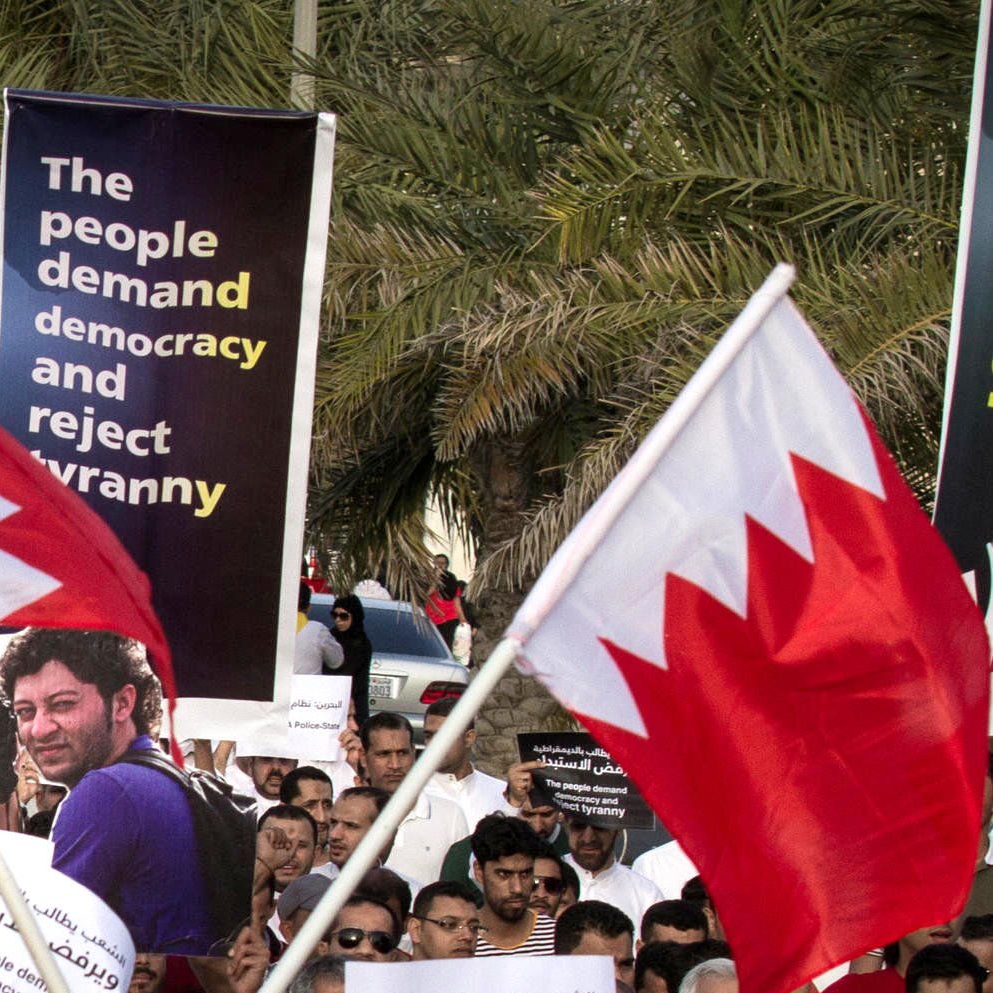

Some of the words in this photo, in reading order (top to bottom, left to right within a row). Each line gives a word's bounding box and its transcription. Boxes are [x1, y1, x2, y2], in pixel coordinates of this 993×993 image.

[41, 156, 133, 202] The
[40, 210, 218, 266] people
[37, 252, 250, 310] demand
[35, 306, 267, 370] democracy
[31, 356, 127, 401] and
[29, 406, 171, 456] reject
[291, 700, 311, 710] نظام
[546, 779, 561, 788] The
[563, 782, 591, 792] people
[593, 785, 627, 794] demand
[554, 792, 601, 804] democracy
[601, 797, 619, 805] and
[581, 804, 625, 818] tyranny
[33, 904, 79, 934] يطالب
[81, 930, 127, 968] الشعب
